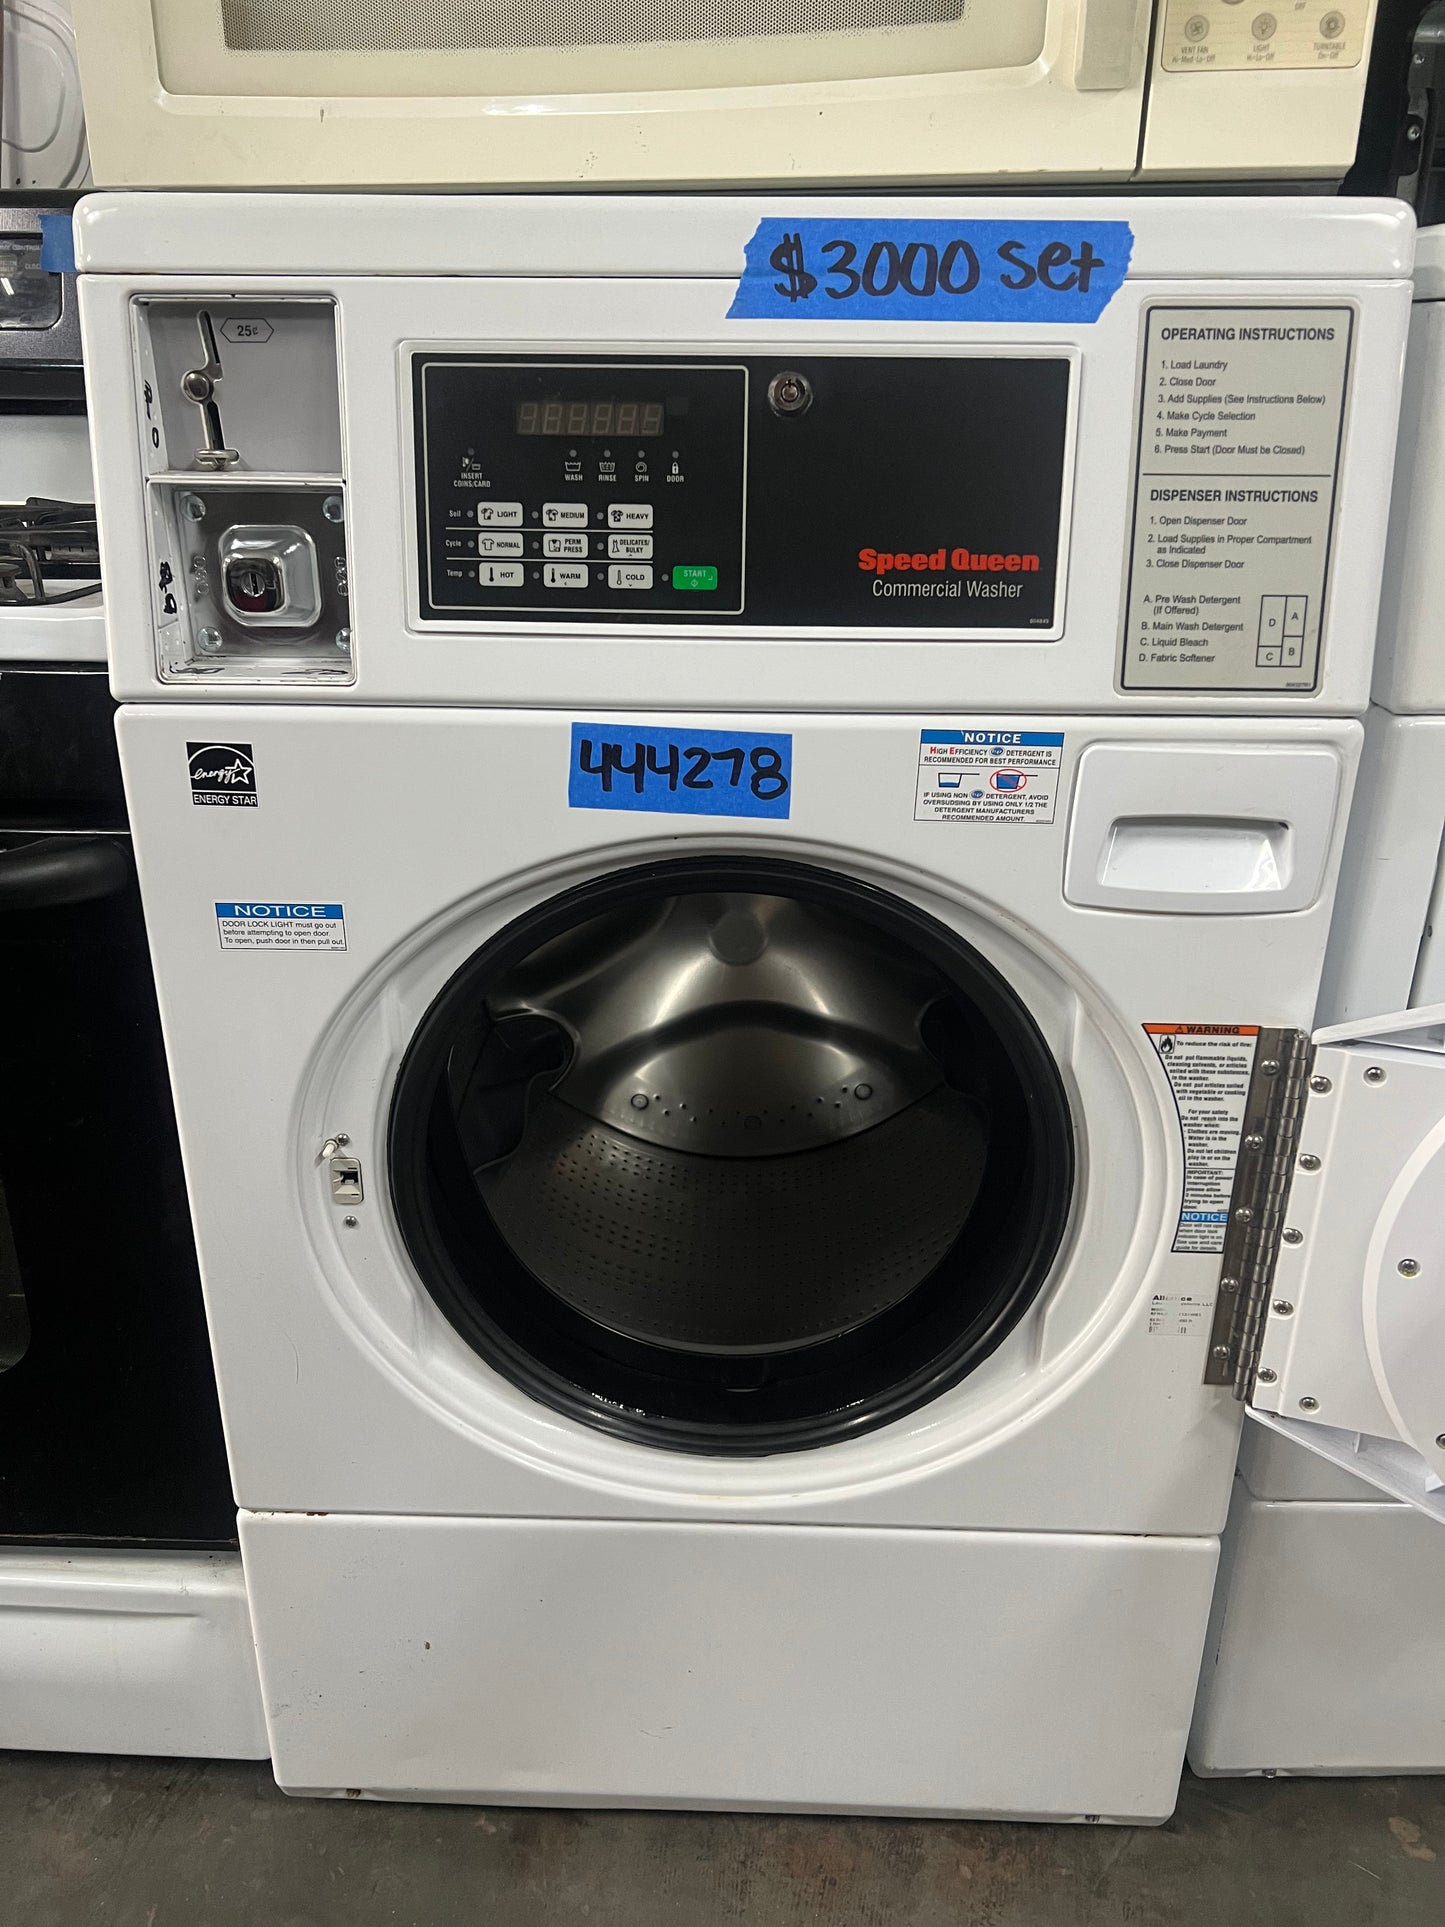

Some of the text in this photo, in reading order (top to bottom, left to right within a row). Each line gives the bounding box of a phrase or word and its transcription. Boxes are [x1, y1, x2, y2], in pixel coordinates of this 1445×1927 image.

[769, 233, 981, 303] $3000
[1161, 328, 1335, 340] OPERATING INSTRUCTIONS
[1162, 361, 1228, 371] 1. Load Laundry
[1159, 378, 1216, 386] 2. Close Door
[1158, 395, 1325, 405] 3. Add Supplies (See Instructions Below)
[1157, 412, 1256, 422] 4. Make Cycle Selection
[1156, 429, 1227, 439] 5. Make Payment
[1154, 445, 1304, 456] 6. Press Start (Door Must be Closed)
[666, 475, 684, 483] DOOR
[1150, 490, 1318, 502] DISPENSER INSTRUCTIONS
[449, 510, 461, 518] Soil
[1160, 516, 1181, 526] Open
[1184, 517, 1225, 526] Dispenser
[1227, 517, 1247, 525] Door
[1148, 534, 1312, 545] 2. Load Supplies in Proper Compartment
[1169, 546, 1206, 554] Indicated
[858, 548, 1040, 574] Speed Queen
[1146, 560, 1244, 570] 3. Close Dispenser Door
[872, 579, 1023, 599] Commercial Washer
[1144, 595, 1240, 606] A. Pre Wash Detergent
[1153, 606, 1199, 616] (If Offered)
[1291, 612, 1298, 620] A
[1141, 622, 1243, 632] B. Main Wash Detergent
[1269, 619, 1276, 627] D
[1140, 638, 1208, 648] C. Liquid Bleach
[1266, 653, 1273, 661] C
[1288, 648, 1295, 656] B
[1139, 654, 1215, 662] D. Fabric Softener
[964, 733, 1021, 743] NOTICE
[930, 747, 948, 755] HIGH
[949, 747, 987, 756] EFFICIENCY
[580, 739, 788, 800] 444278
[194, 795, 256, 805] ENERGY STAR
[234, 905, 326, 917] NOTICE
[1187, 1026, 1240, 1034] WARNING
[1182, 1213, 1228, 1221] NOTICE
